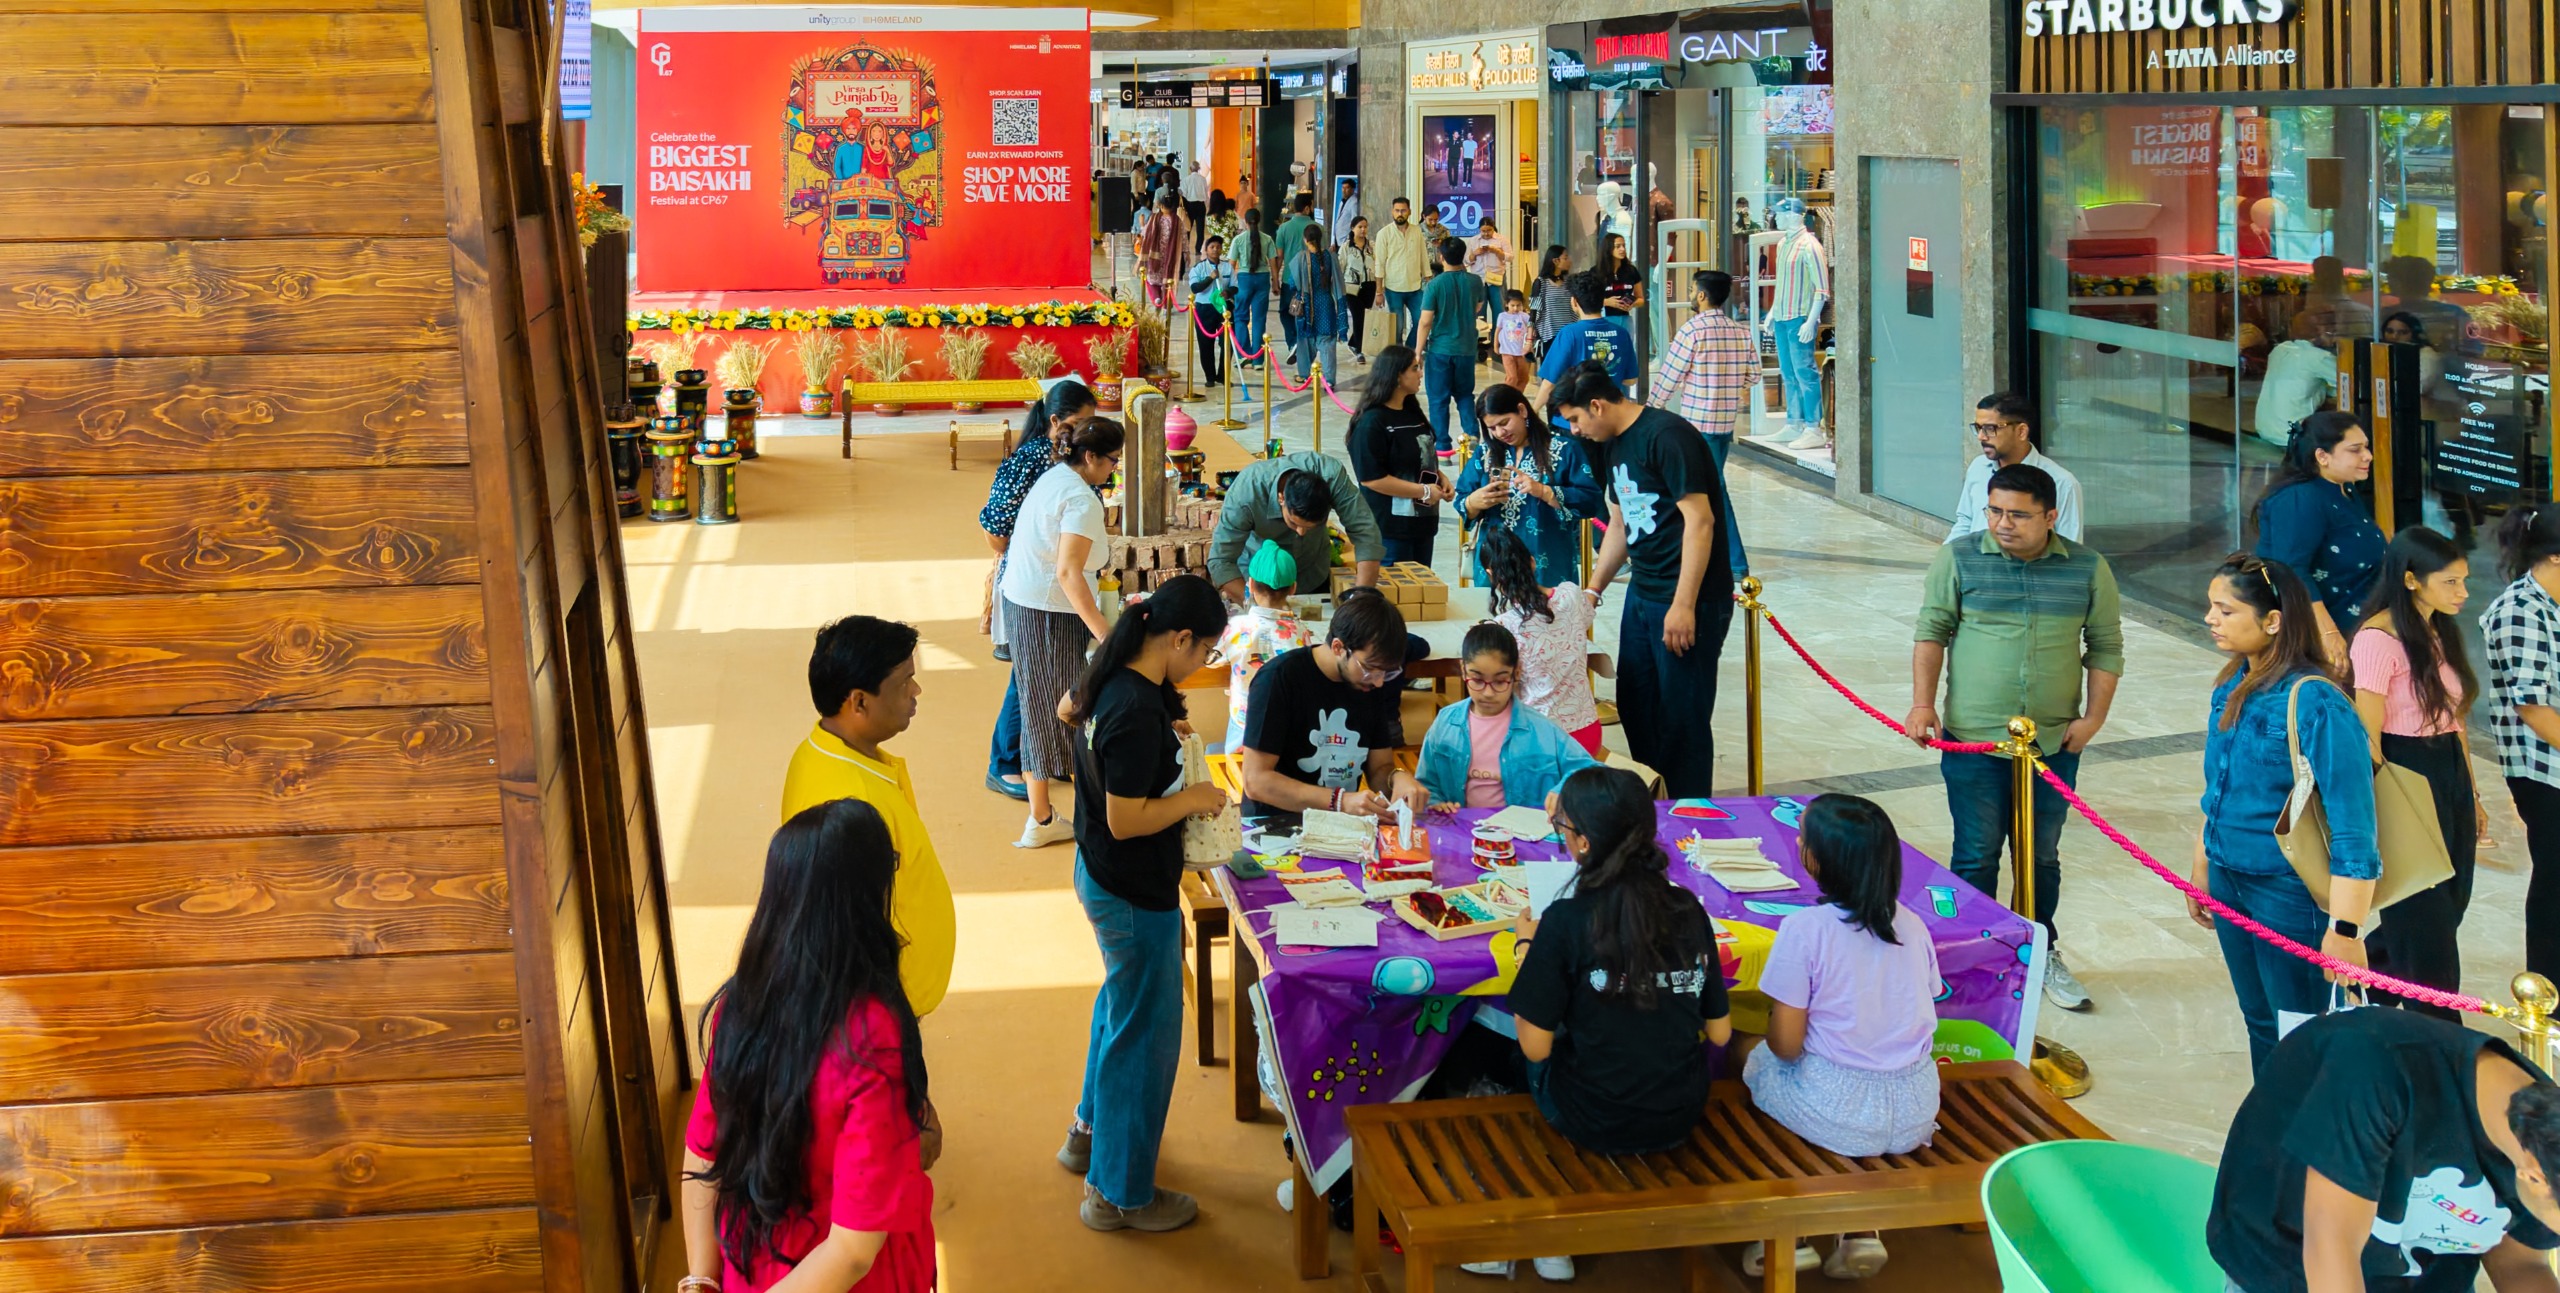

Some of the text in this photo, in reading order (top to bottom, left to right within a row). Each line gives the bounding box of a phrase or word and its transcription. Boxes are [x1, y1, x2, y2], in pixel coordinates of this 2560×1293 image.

[2025, 0, 2283, 37] STARBUCKS
[1595, 31, 1669, 65] TRUE RELIGION
[1681, 28, 1788, 62] GANT
[2146, 44, 2297, 69] A TATA Alliance
[1411, 72, 1467, 88] BEVERLY HILLS
[1485, 67, 1538, 85] POLO CLUB
[1122, 90, 1133, 101] G
[650, 132, 716, 142] Celebrate the
[650, 145, 752, 167] BIGGEST
[989, 151, 999, 159] 2X
[1001, 151, 1034, 159] REWARD
[1035, 151, 1063, 159] POINTS
[650, 171, 751, 191] BAISAKHI
[963, 166, 1071, 183] SHOP MORE
[650, 195, 728, 205] Festival at CP67
[963, 184, 1071, 203] SAVE MORE
[1437, 201, 1483, 229] 20
[2464, 362, 2489, 372] HOURS
[2461, 418, 2494, 430] FREE WI-FI
[2470, 434, 2494, 443] SMOKING
[2472, 459, 2487, 467] FOOD
[2492, 476, 2520, 488] RESERVED
[1946, 1043, 1960, 1053] us
[1964, 1045, 1982, 1058] on
